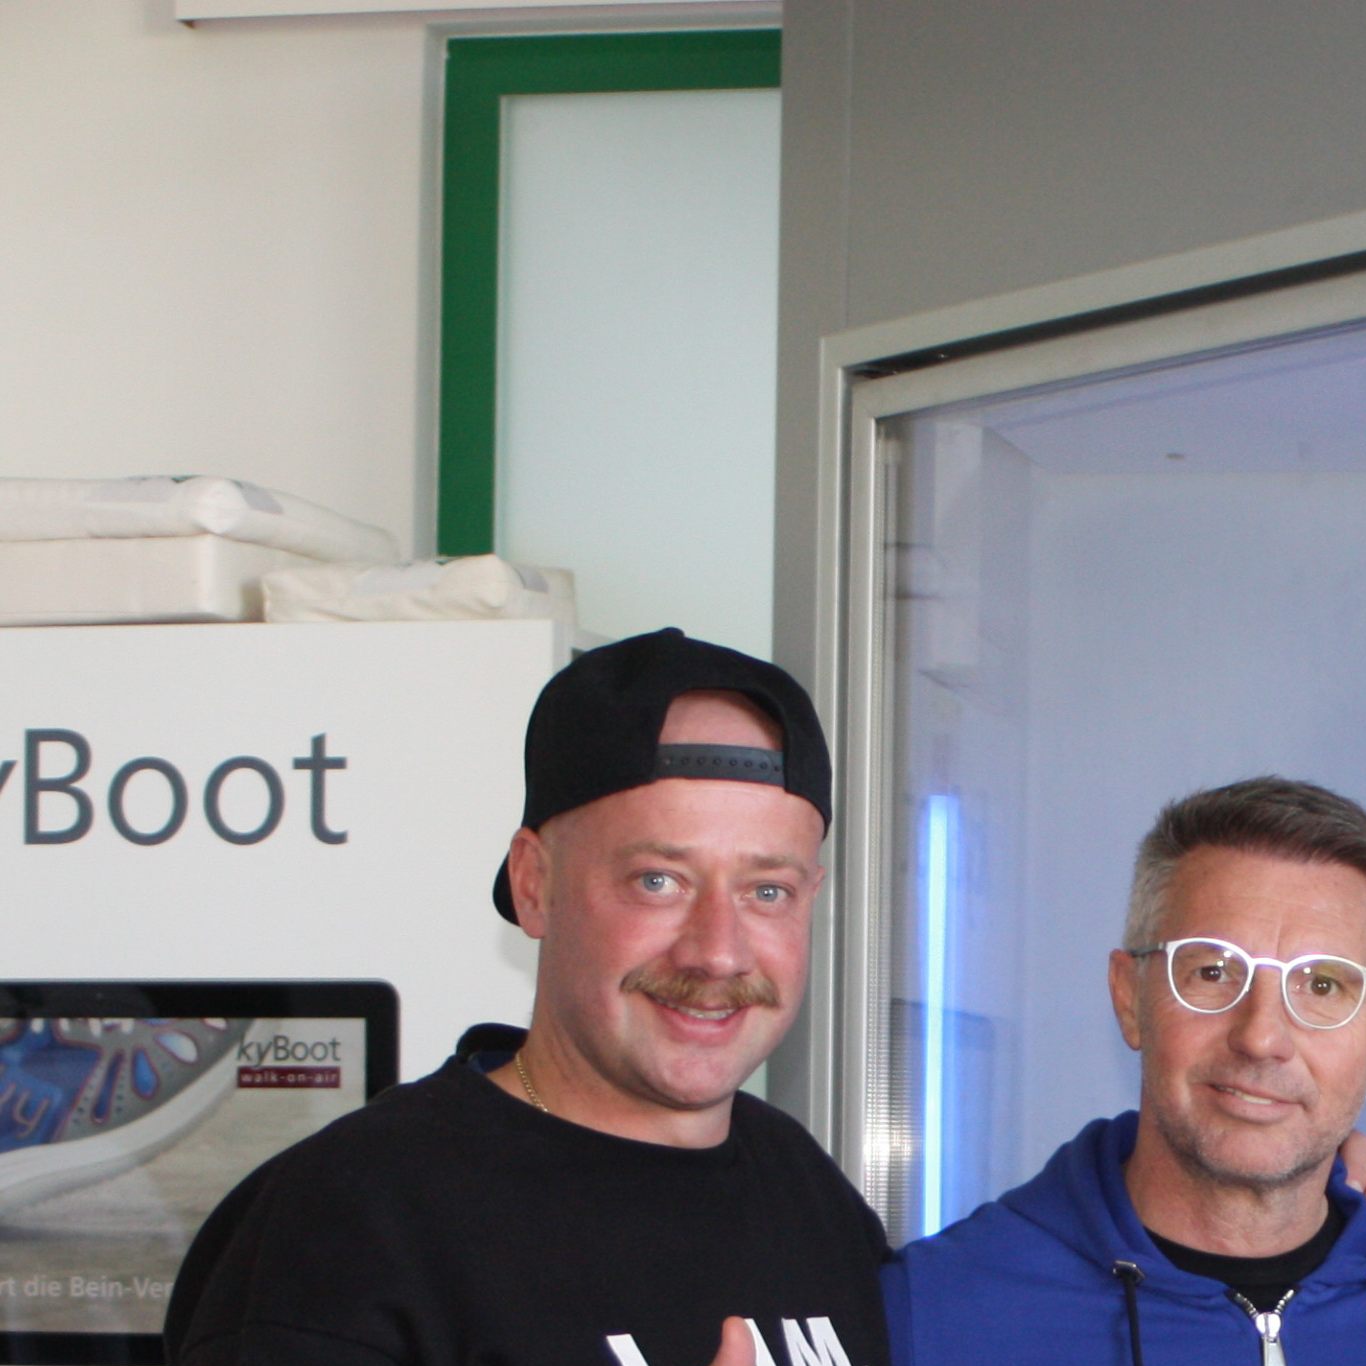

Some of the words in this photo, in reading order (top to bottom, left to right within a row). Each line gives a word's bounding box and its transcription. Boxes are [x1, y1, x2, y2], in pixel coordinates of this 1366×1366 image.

[0, 727, 348, 846] Boot
[237, 1034, 342, 1068] kyBoot
[241, 1071, 339, 1084] walk-on-air
[23, 1274, 62, 1298] die
